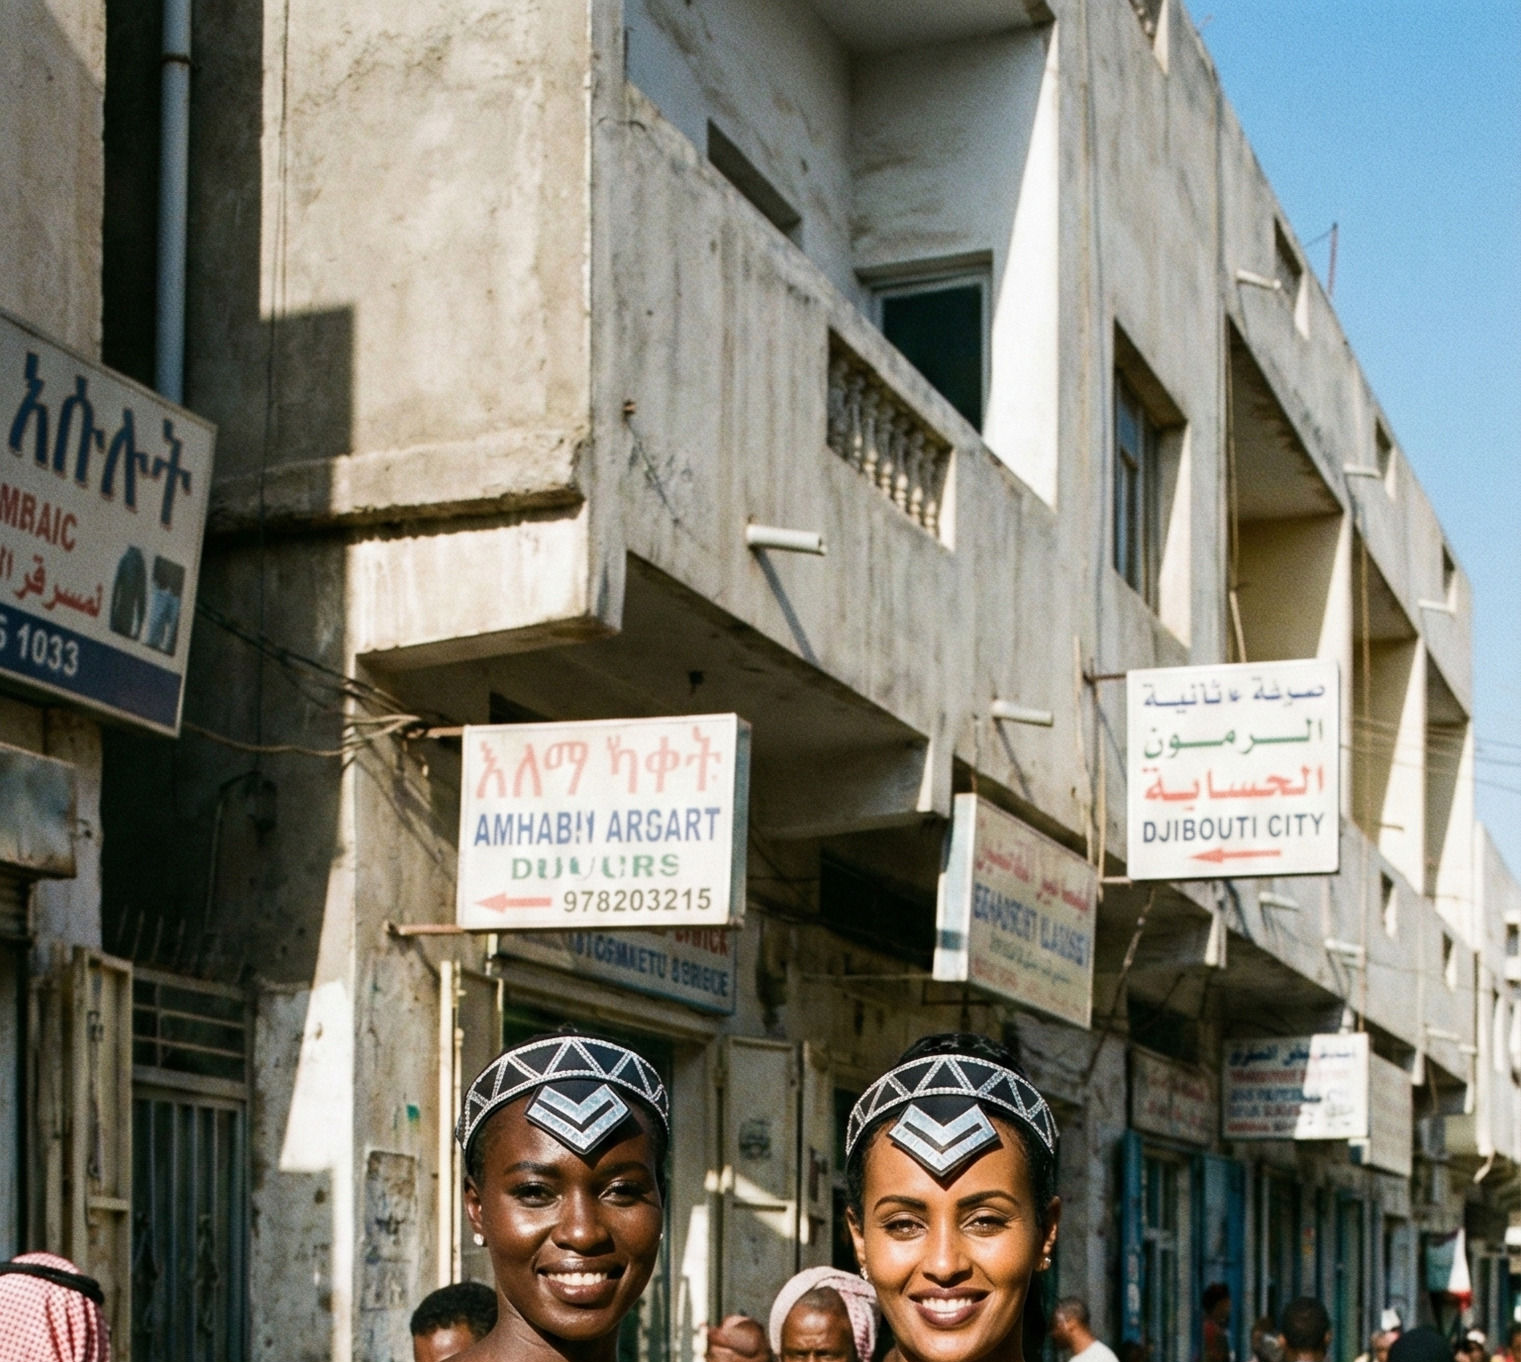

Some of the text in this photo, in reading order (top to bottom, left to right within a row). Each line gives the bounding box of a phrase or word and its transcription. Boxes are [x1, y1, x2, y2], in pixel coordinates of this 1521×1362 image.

[17, 622, 79, 677] 1033
[1143, 813, 1324, 843] DJIBOUTI CITY
[563, 888, 712, 912] 978203215
